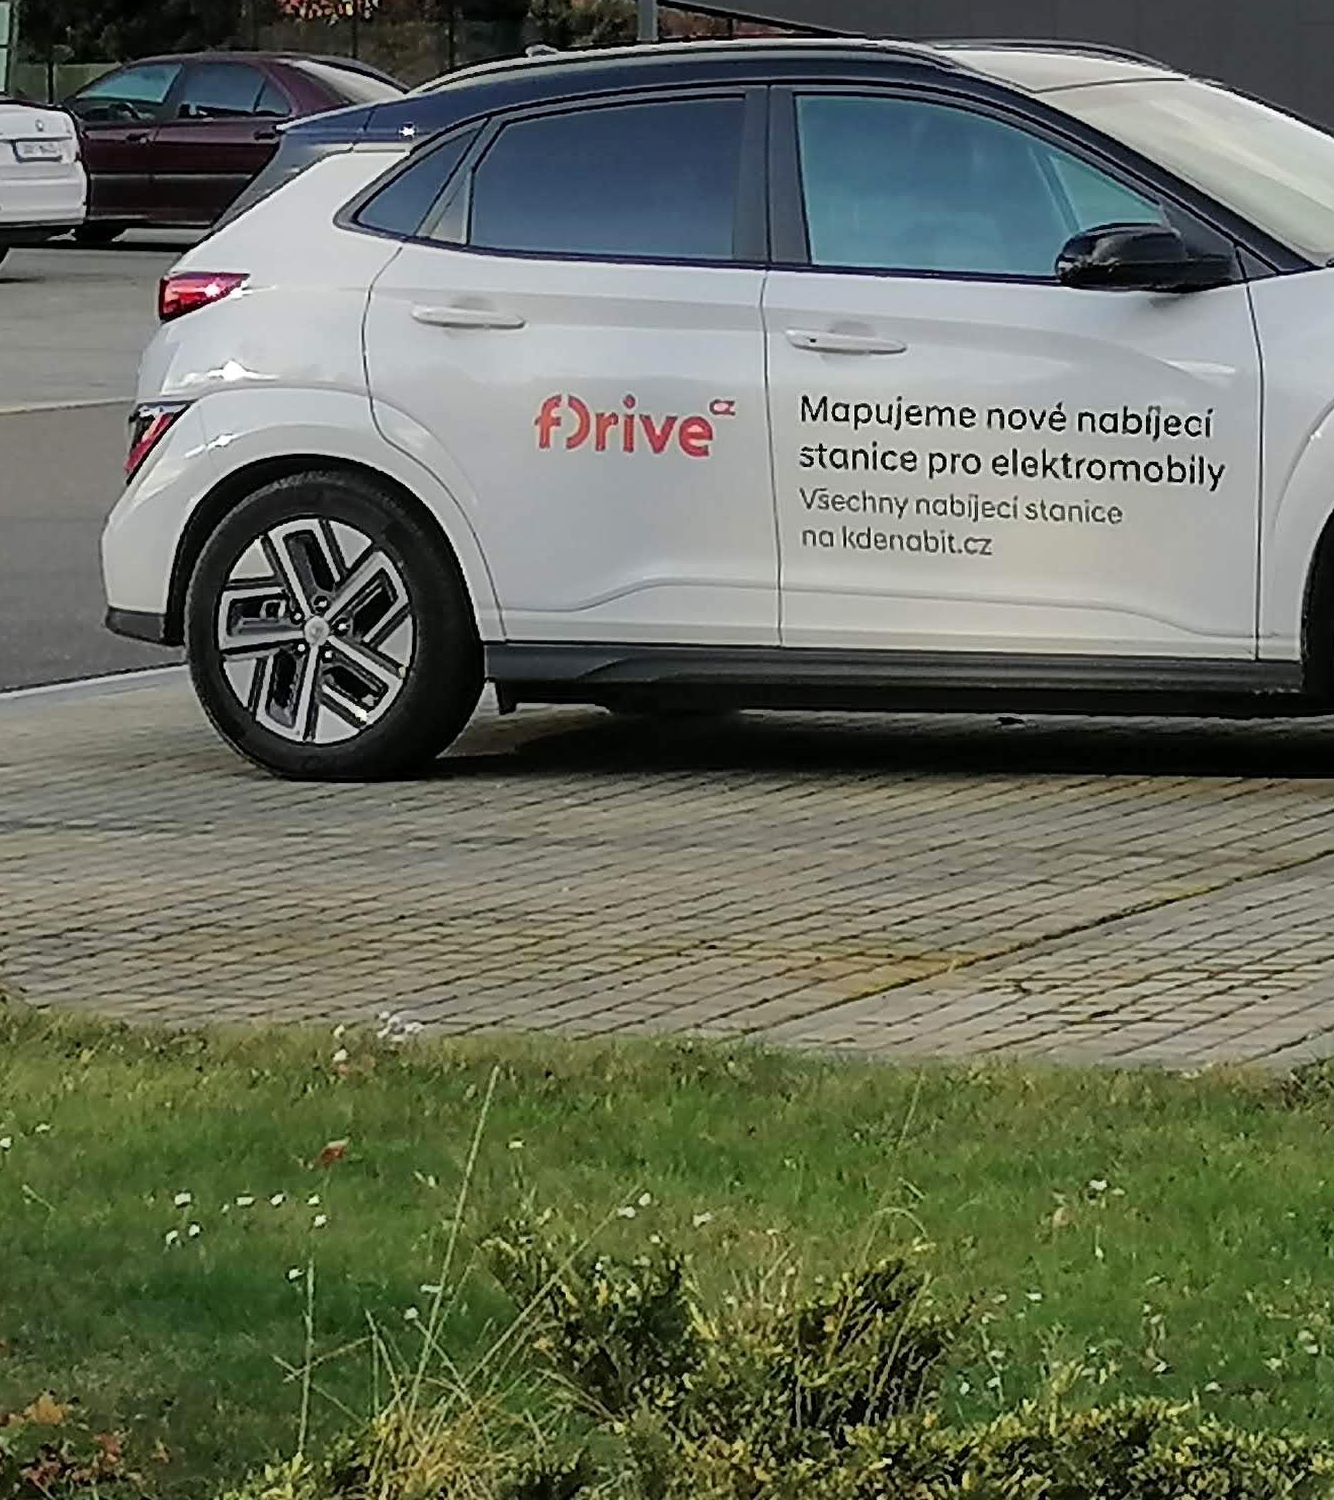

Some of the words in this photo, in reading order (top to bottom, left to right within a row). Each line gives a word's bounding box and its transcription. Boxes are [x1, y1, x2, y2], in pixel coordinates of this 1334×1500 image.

[800, 394, 977, 431] Mapujeme
[986, 401, 1068, 432] nové
[1077, 405, 1215, 442] nabíjecí
[799, 441, 918, 472] stanice
[928, 451, 982, 480] pro
[991, 448, 1226, 492] elektromobily
[799, 487, 909, 520] Všechny
[915, 494, 1019, 523] nabíjecí
[1024, 498, 1123, 525] stanice
[802, 528, 834, 548] na
[841, 525, 993, 556] kdenabit.cz
